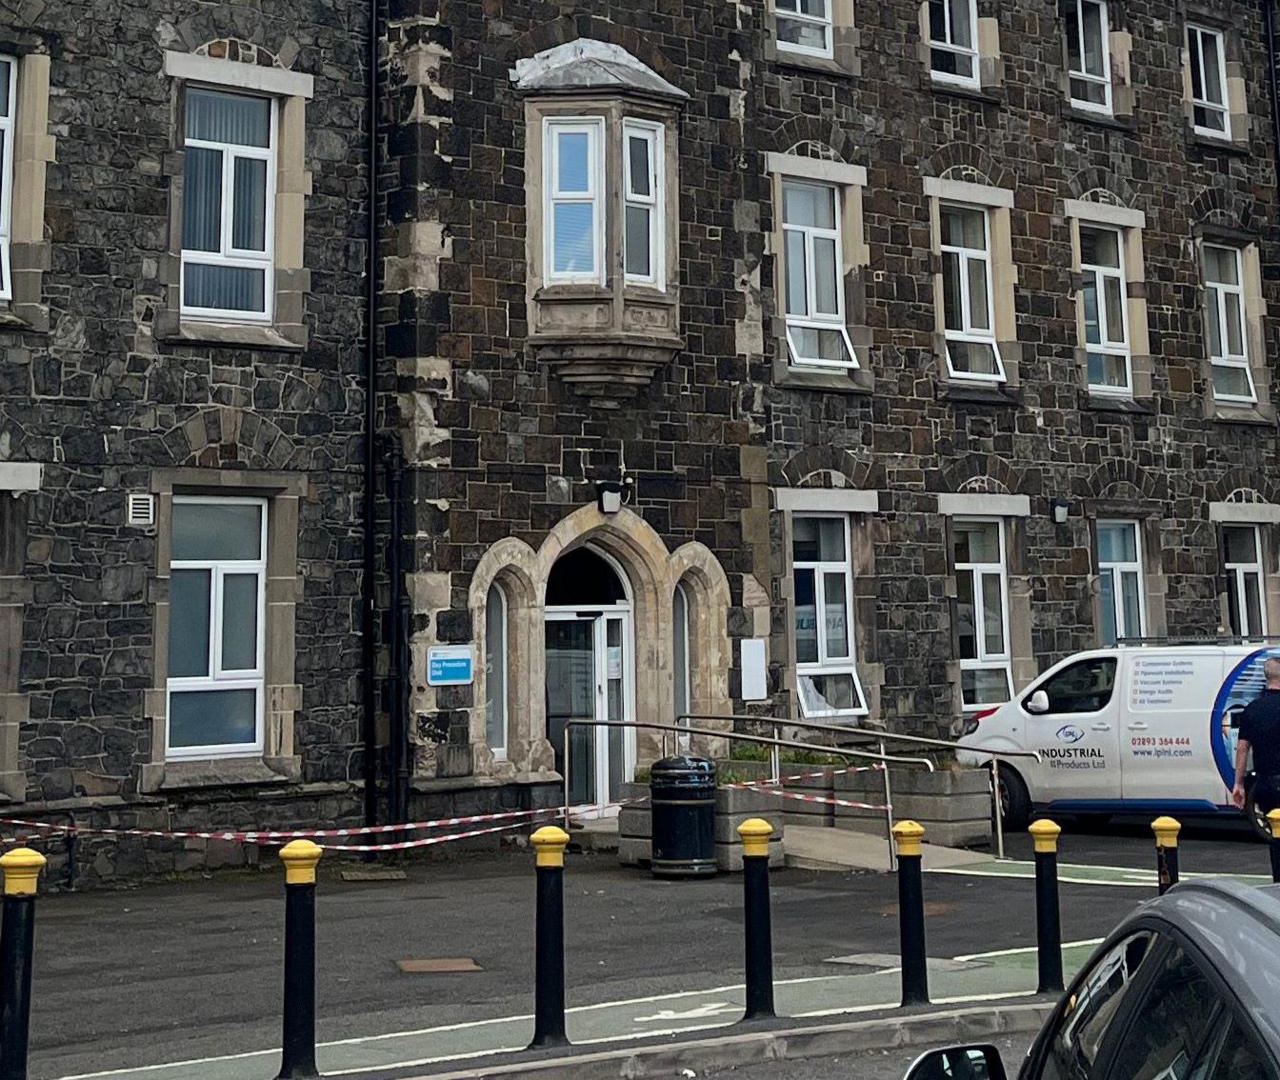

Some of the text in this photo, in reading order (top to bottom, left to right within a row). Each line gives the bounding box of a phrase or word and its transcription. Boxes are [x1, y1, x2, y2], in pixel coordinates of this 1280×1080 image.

[1131, 737, 1156, 746] 02893
[1038, 748, 1105, 758] INDUSTRIAL
[1056, 759, 1106, 769] Products Ltd
